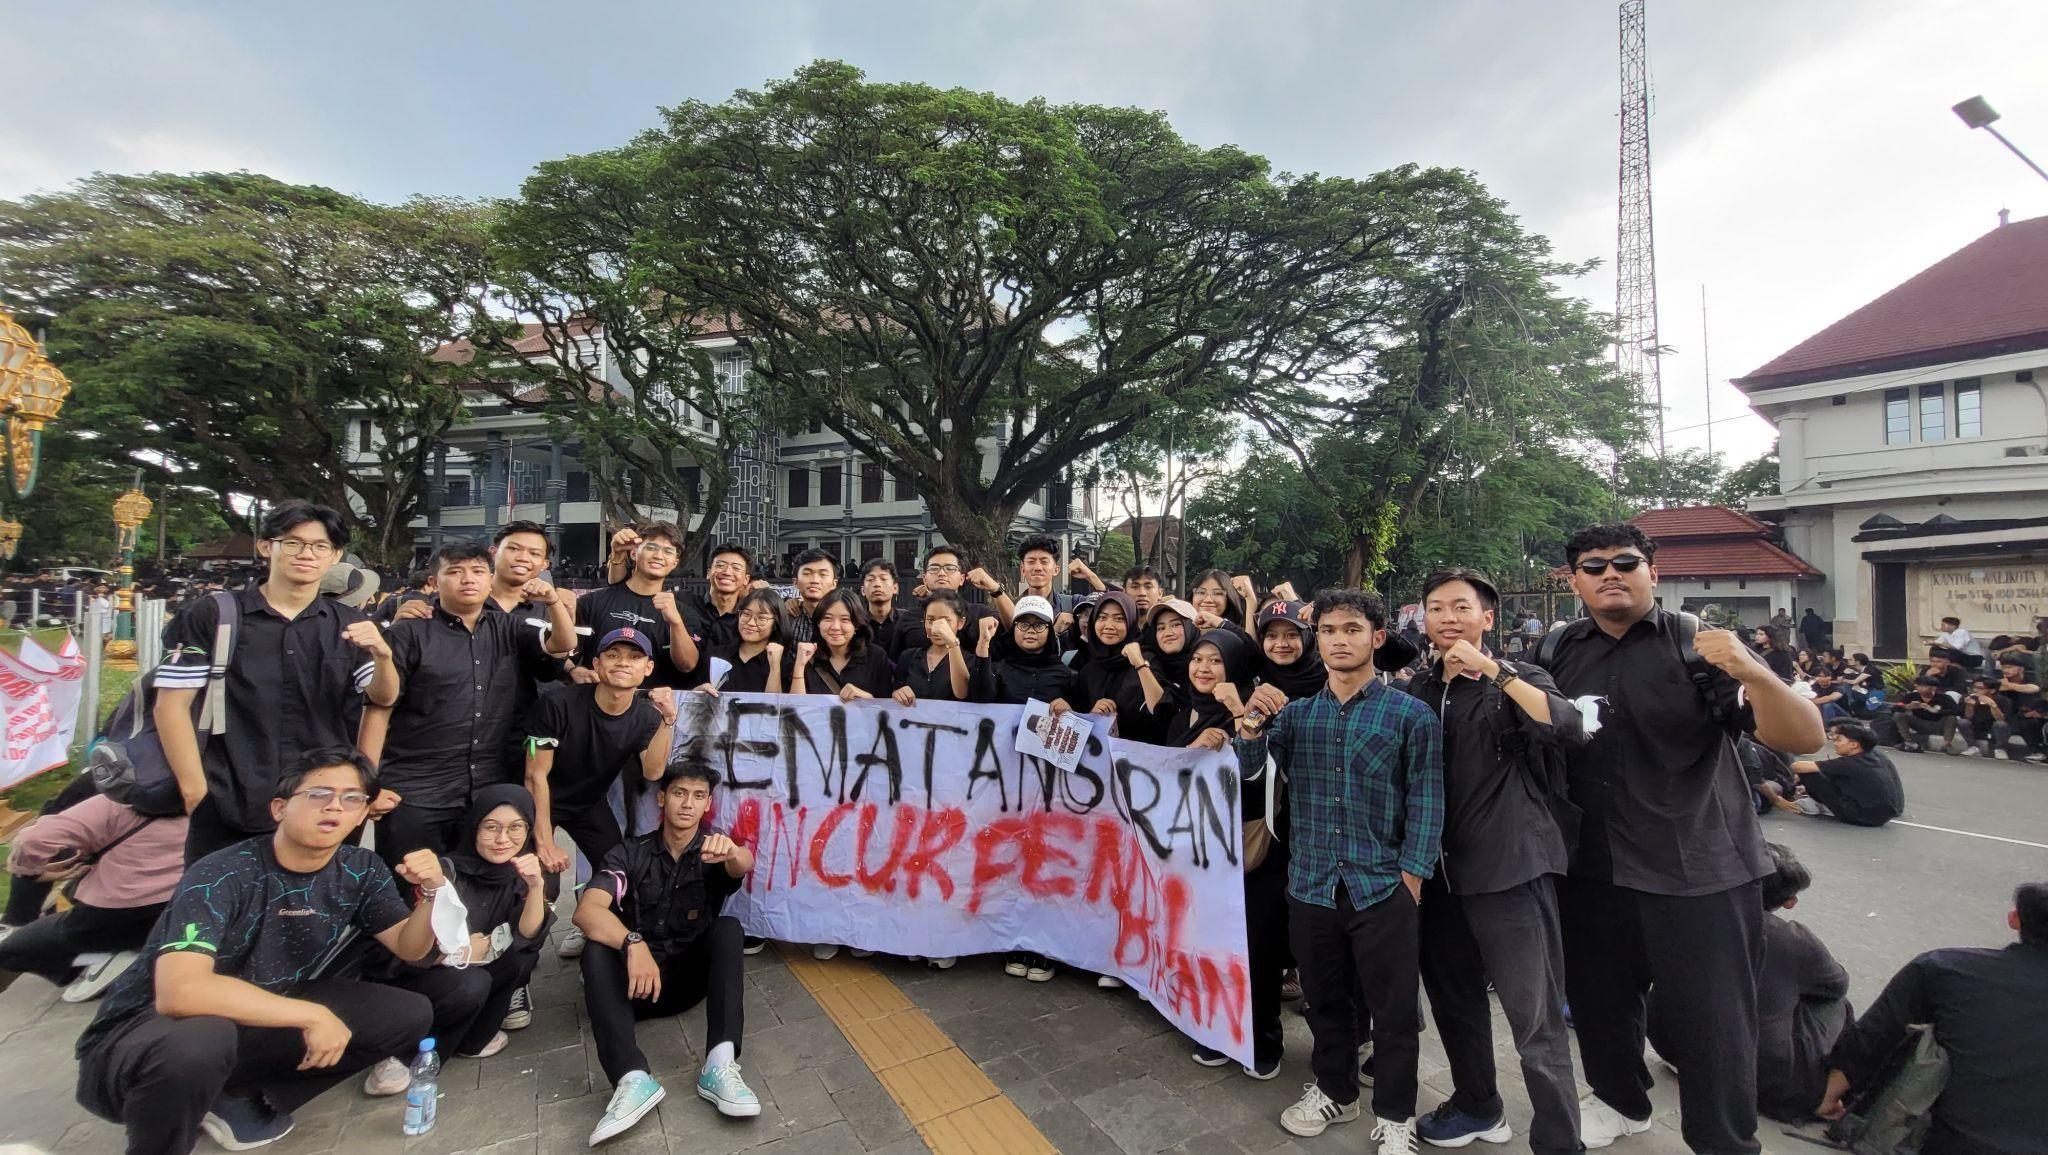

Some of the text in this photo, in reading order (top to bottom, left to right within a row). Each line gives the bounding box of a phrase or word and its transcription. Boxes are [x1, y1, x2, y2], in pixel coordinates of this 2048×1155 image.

[1272, 601, 1287, 615] NY
[1983, 603, 2038, 614] MALANG
[696, 797, 966, 901] ANCUR
